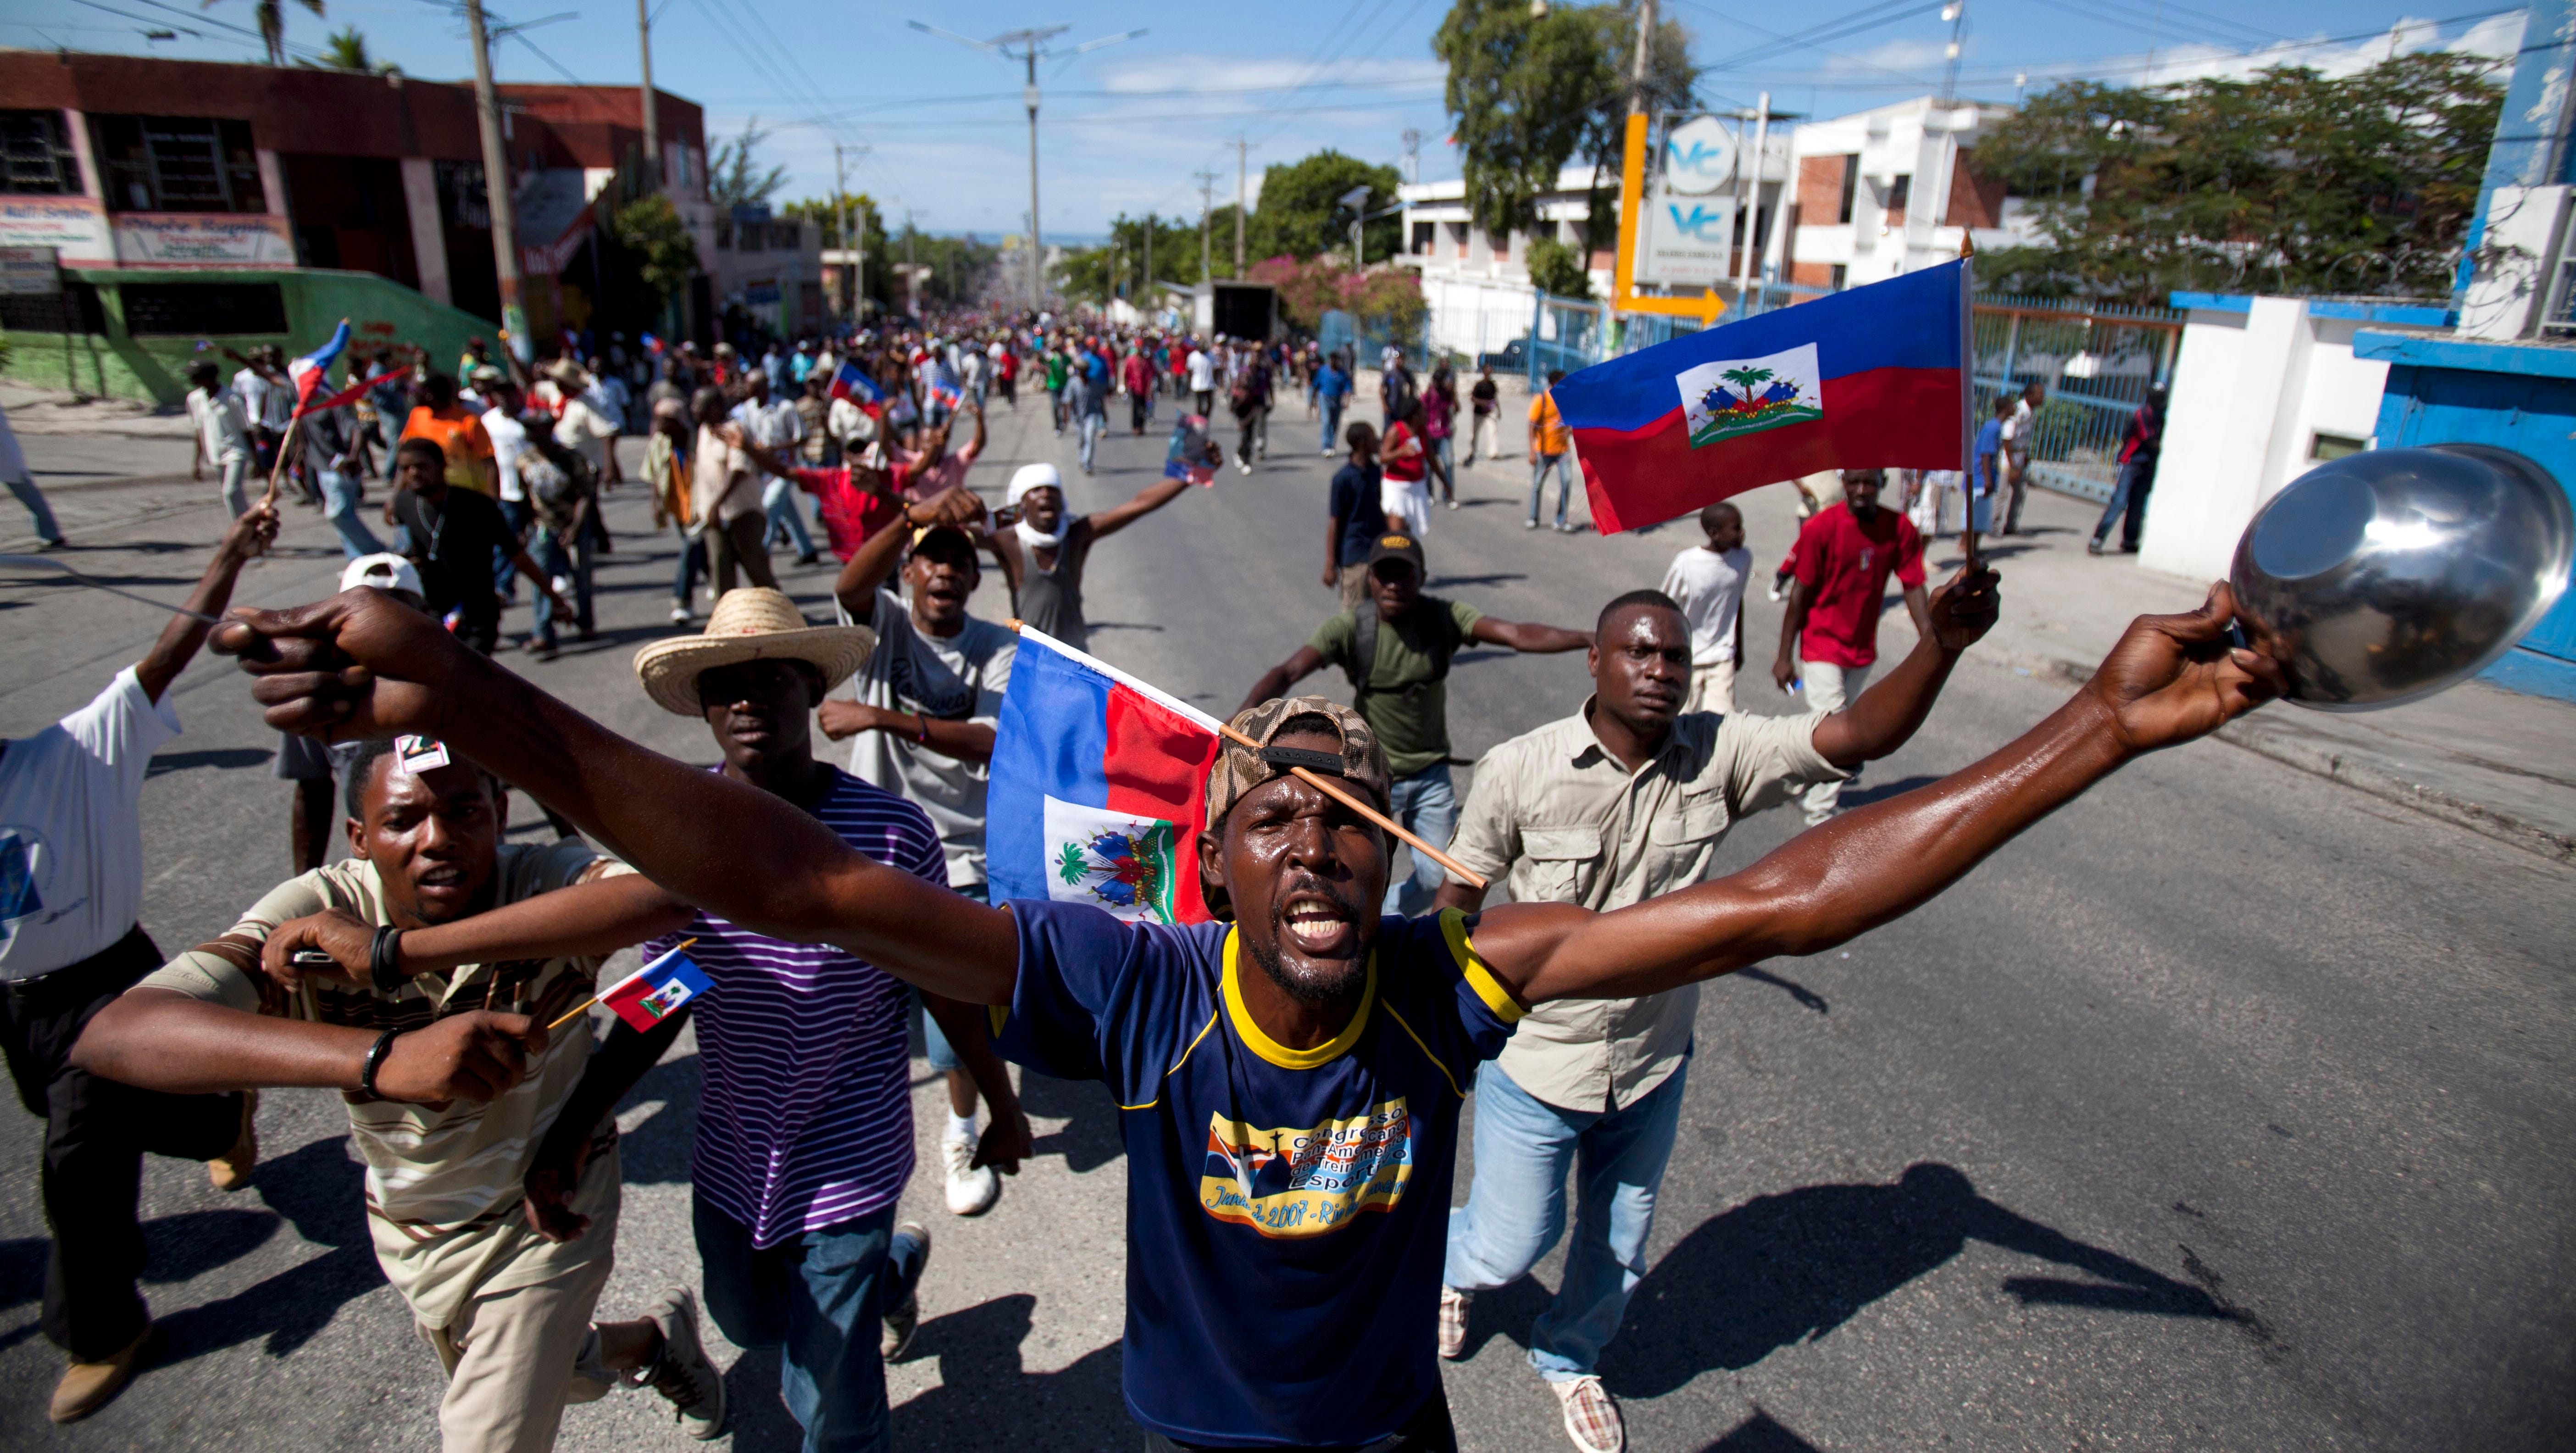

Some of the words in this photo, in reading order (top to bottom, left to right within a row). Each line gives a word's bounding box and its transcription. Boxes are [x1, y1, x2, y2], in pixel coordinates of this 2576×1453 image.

[1292, 1163, 1310, 1176] de
[1252, 1204, 1265, 1222] de
[1267, 1200, 1308, 1228] 2007
[1319, 1201, 1344, 1225] Rio
